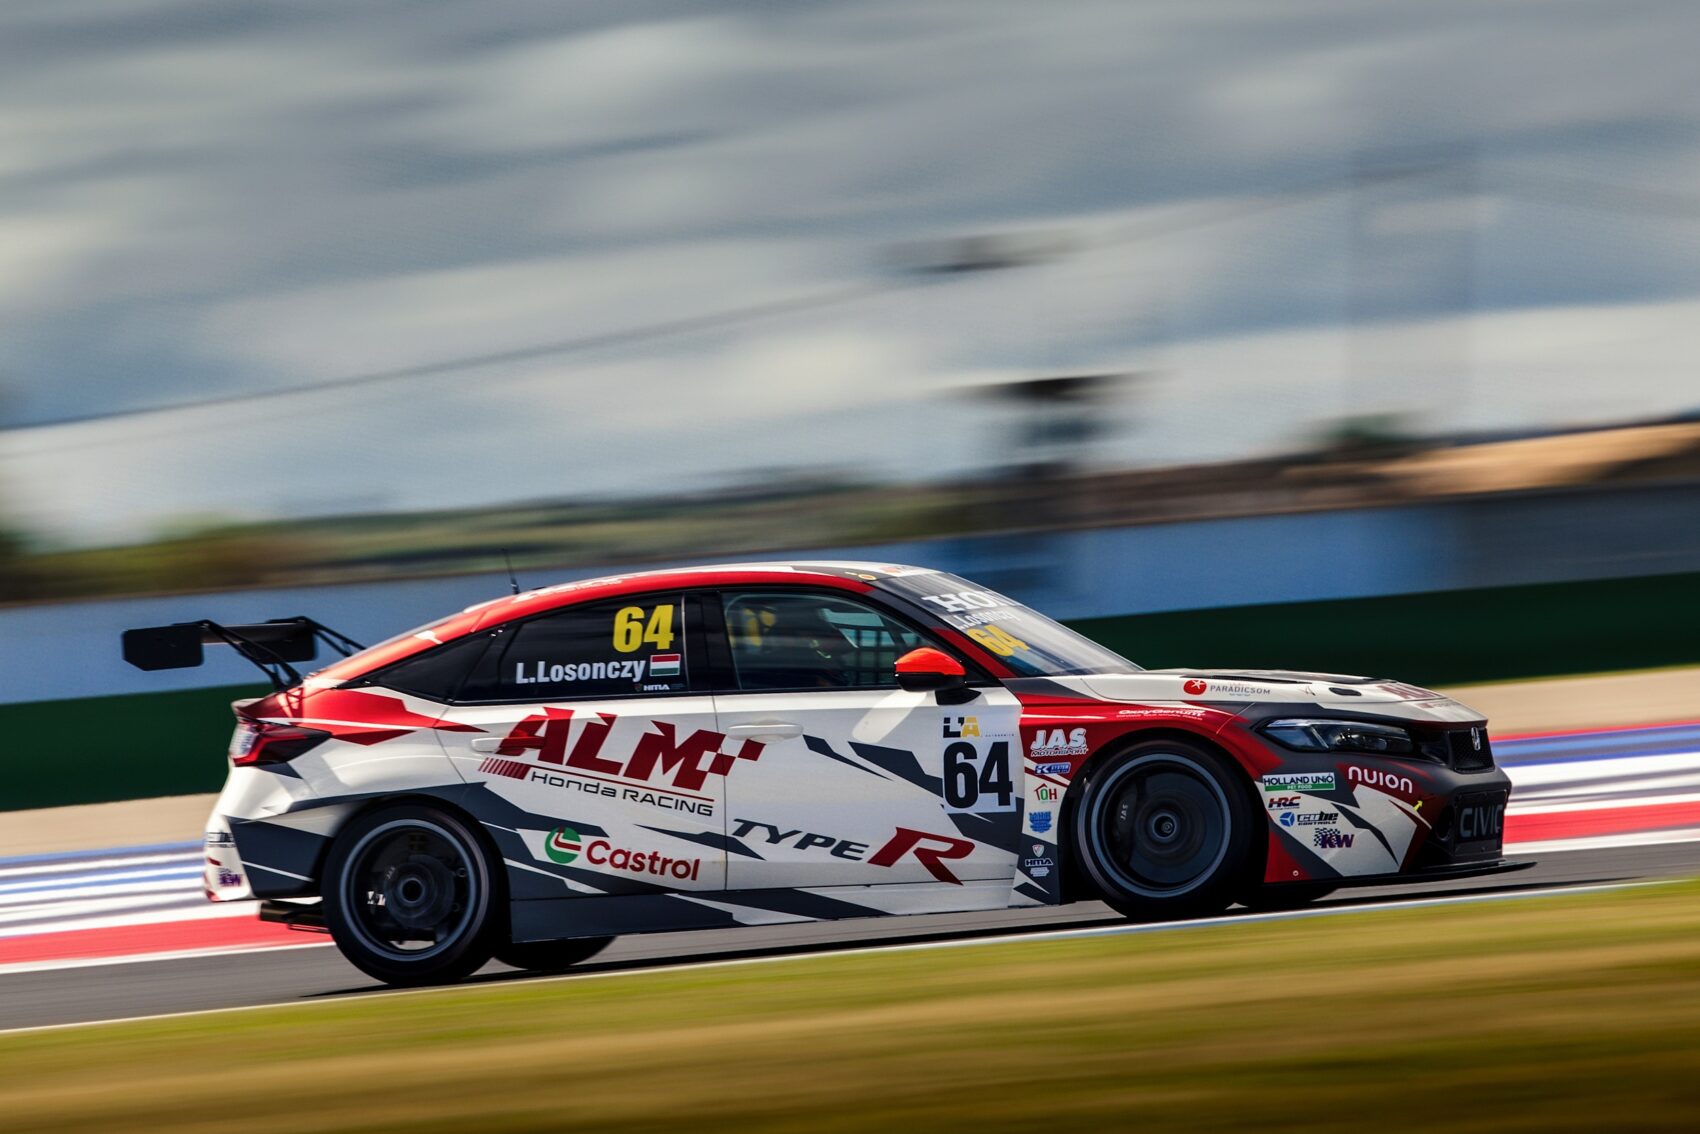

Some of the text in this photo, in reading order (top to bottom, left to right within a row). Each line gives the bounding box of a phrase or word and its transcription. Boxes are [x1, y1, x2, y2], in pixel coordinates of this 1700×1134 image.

[612, 604, 675, 653] 64
[966, 624, 1030, 656] 64
[516, 658, 647, 684] L.Losonczy
[1210, 685, 1271, 695] PARADICSOM
[494, 706, 733, 792] ALM
[943, 741, 1013, 809] 64
[1264, 775, 1310, 786] HOLLAND
[531, 771, 714, 817] Honda RACING
[1268, 796, 1301, 808] HRC
[1460, 804, 1504, 838] CIVIC
[732, 818, 976, 886] TYPE R
[1320, 834, 1355, 849] KW
[586, 839, 701, 882] Castrol
